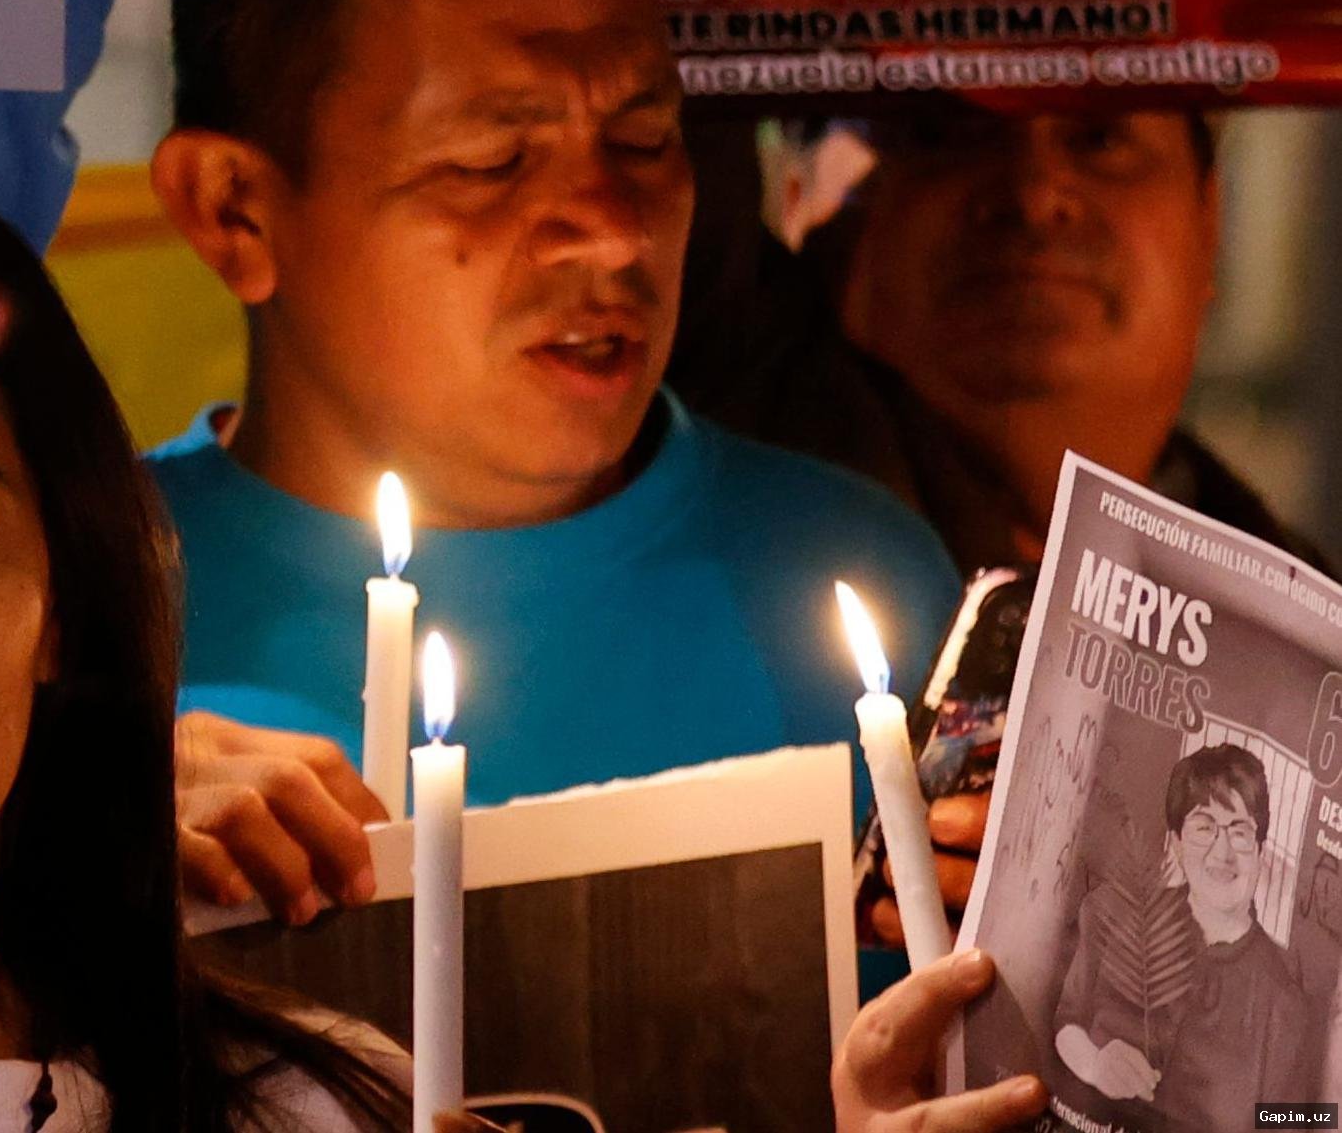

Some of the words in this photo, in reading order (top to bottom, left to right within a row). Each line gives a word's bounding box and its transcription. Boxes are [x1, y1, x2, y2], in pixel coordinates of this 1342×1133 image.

[728, 8, 903, 43] RINDAS
[878, 46, 1087, 90] estamos
[1099, 492, 1190, 551] PERSECUCIÓN
[1071, 548, 1212, 667] MERYS
[1065, 620, 1211, 735] TORRES
